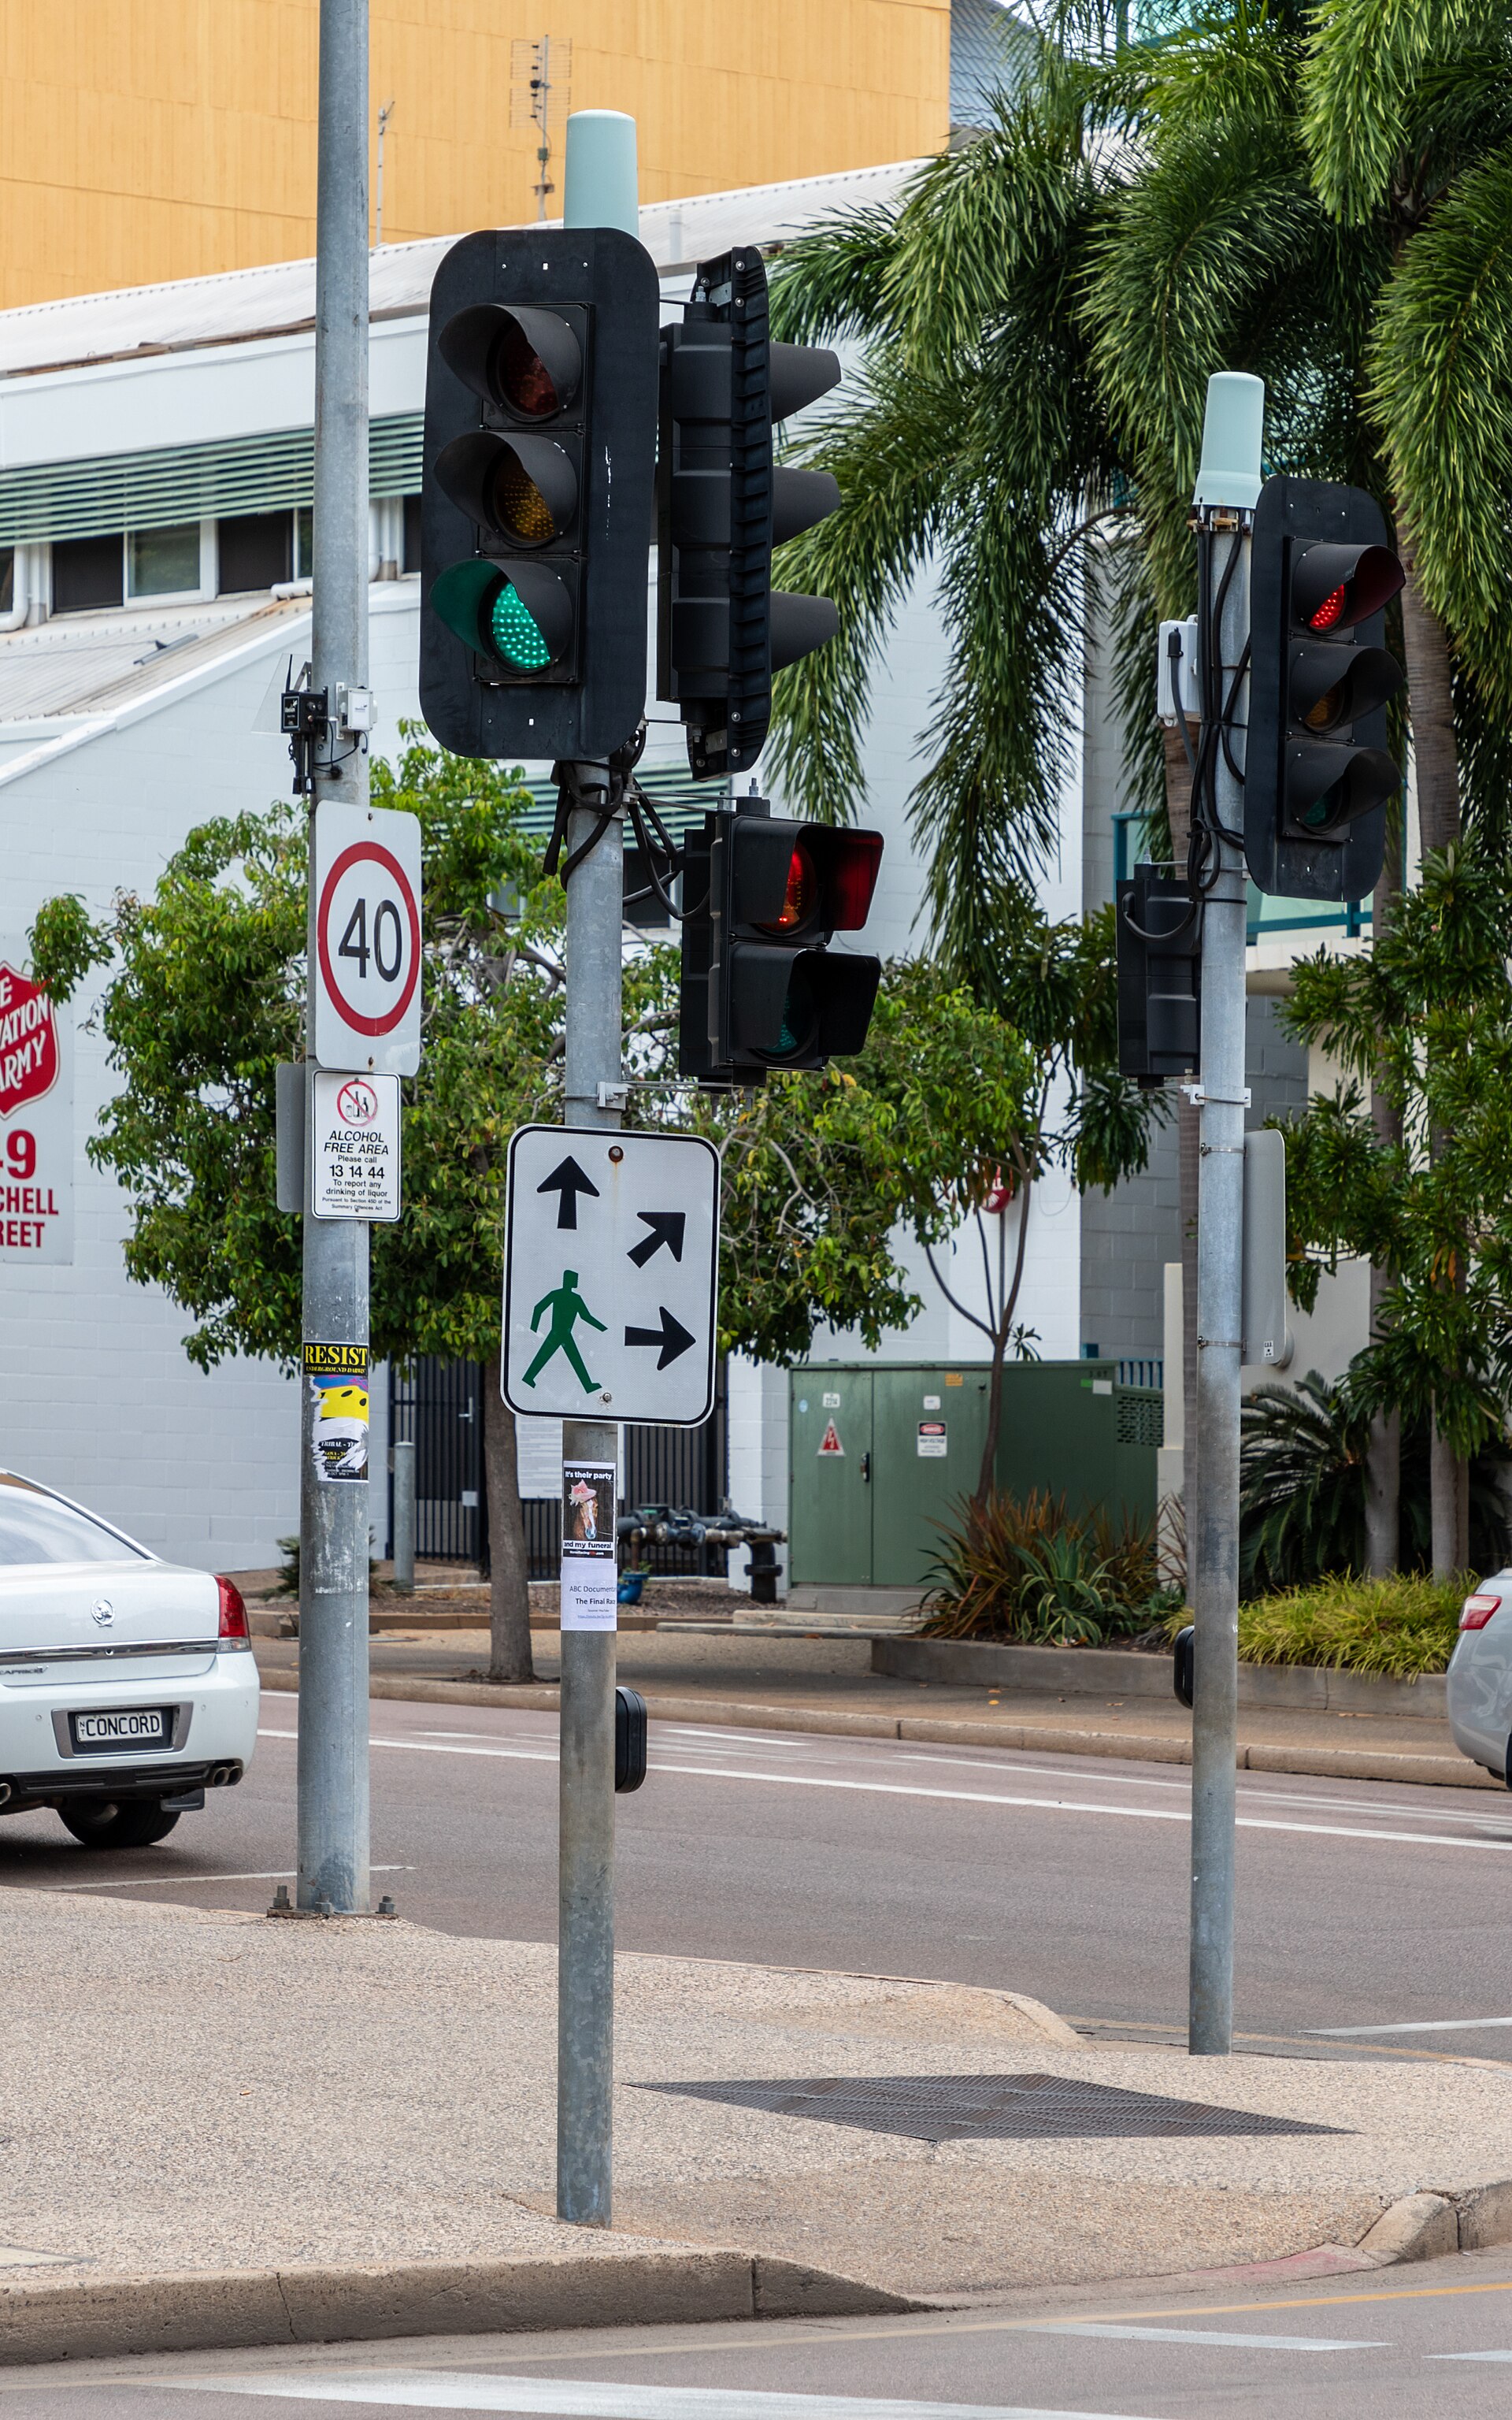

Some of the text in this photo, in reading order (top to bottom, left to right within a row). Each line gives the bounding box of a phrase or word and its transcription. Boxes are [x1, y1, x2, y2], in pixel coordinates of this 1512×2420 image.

[339, 898, 402, 982] 40
[0, 993, 48, 1051] ATION
[329, 1130, 384, 1143] ALCOHOL
[324, 1142, 389, 1155] FREE AREA
[329, 1164, 385, 1179] 13 14 44
[326, 1188, 356, 1197] drinking
[305, 1345, 368, 1366] RESIST
[86, 1715, 160, 1736] CONCORD
